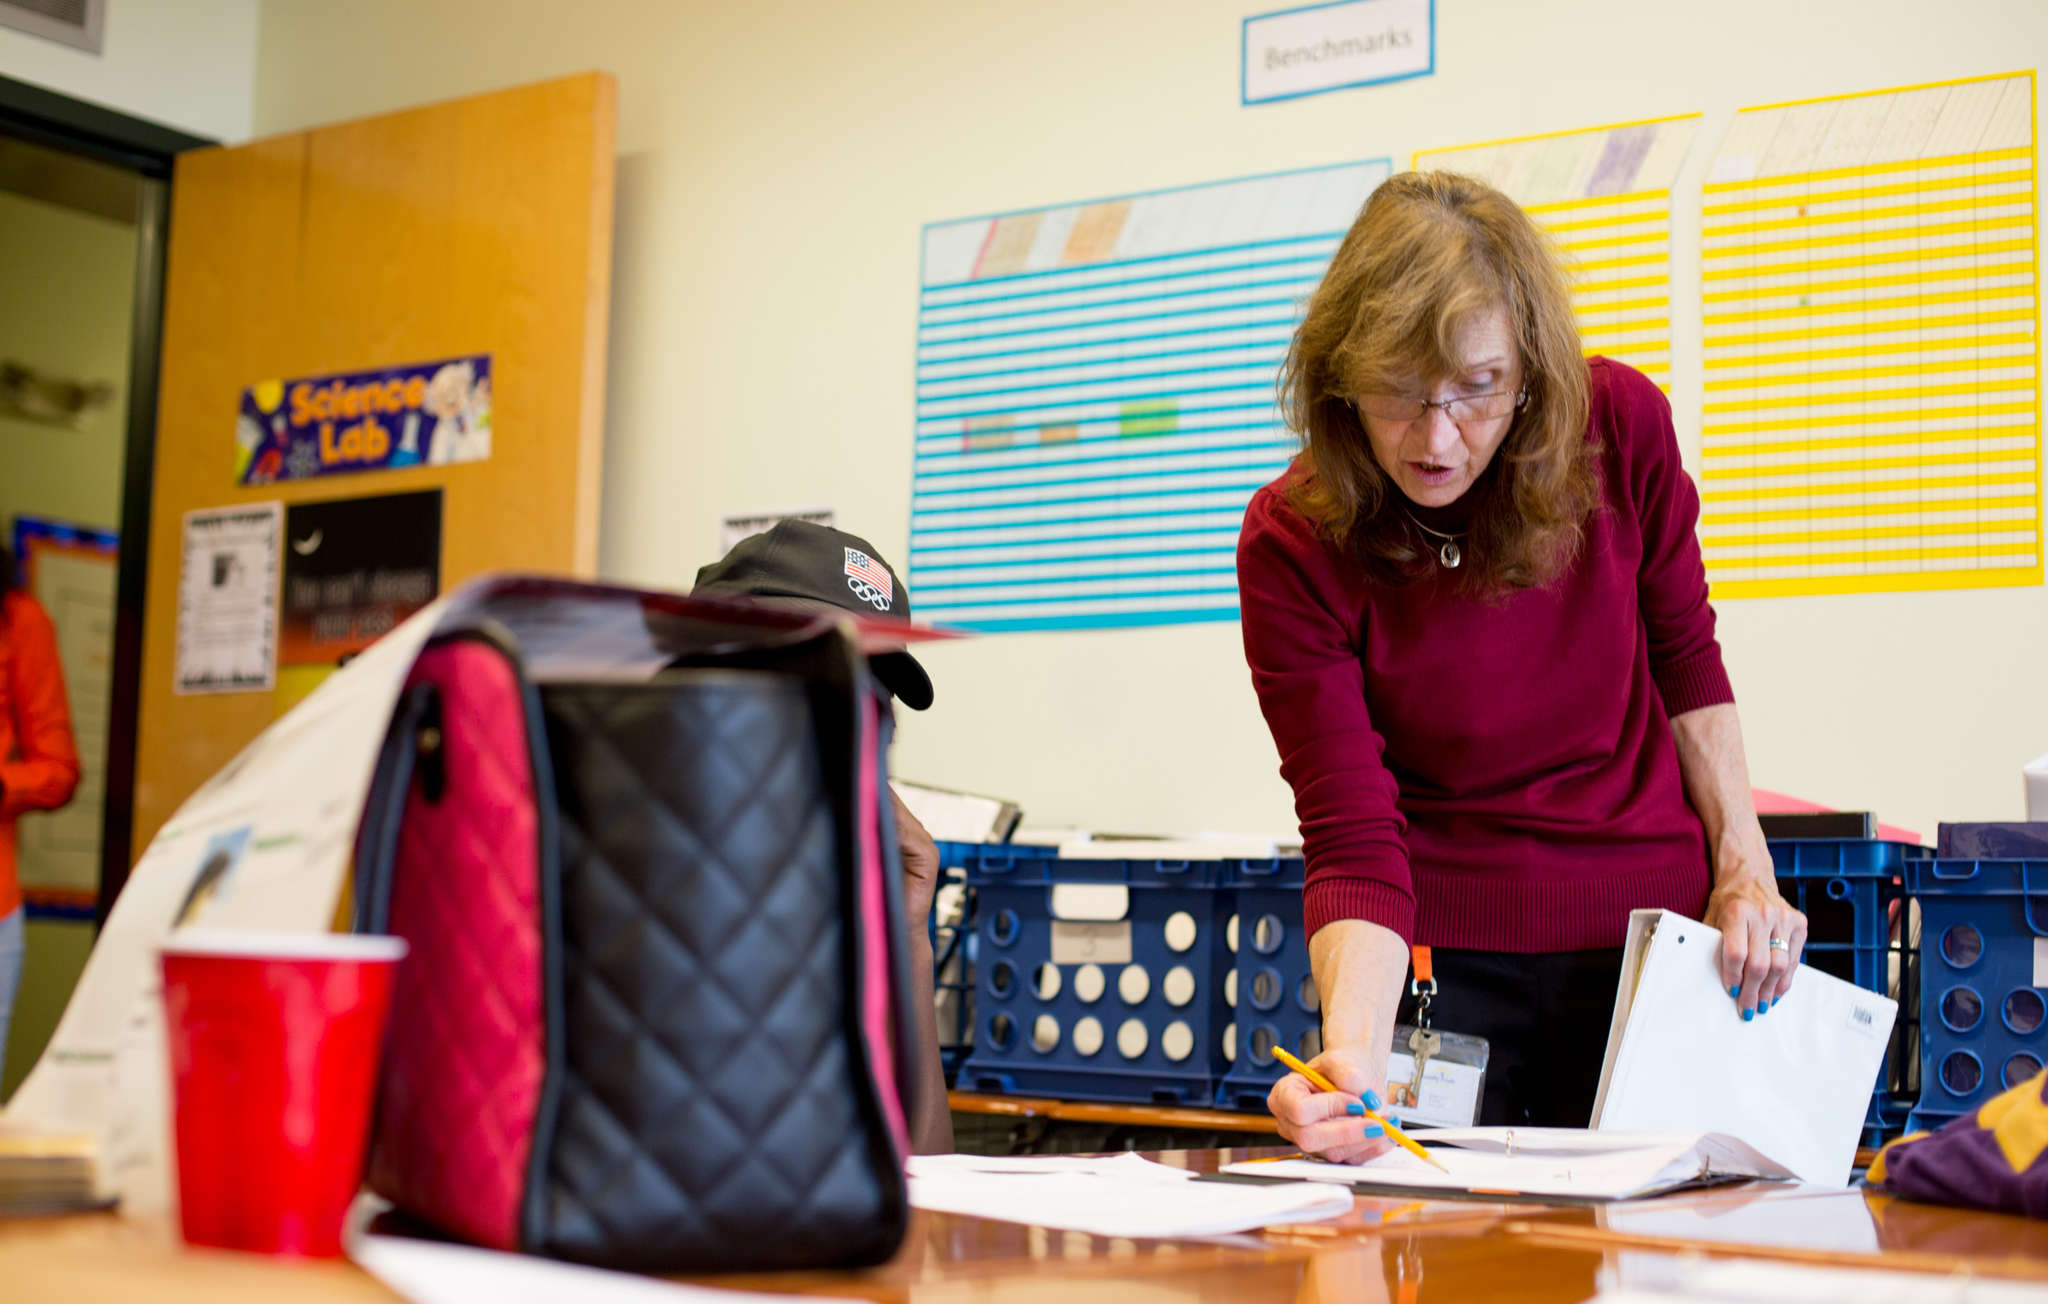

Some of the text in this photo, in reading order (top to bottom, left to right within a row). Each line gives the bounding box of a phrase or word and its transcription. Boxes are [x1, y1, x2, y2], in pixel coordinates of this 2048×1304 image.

[1265, 27, 1413, 70] Benchmarks
[290, 375, 427, 428] Science
[320, 415, 390, 466] Lab
